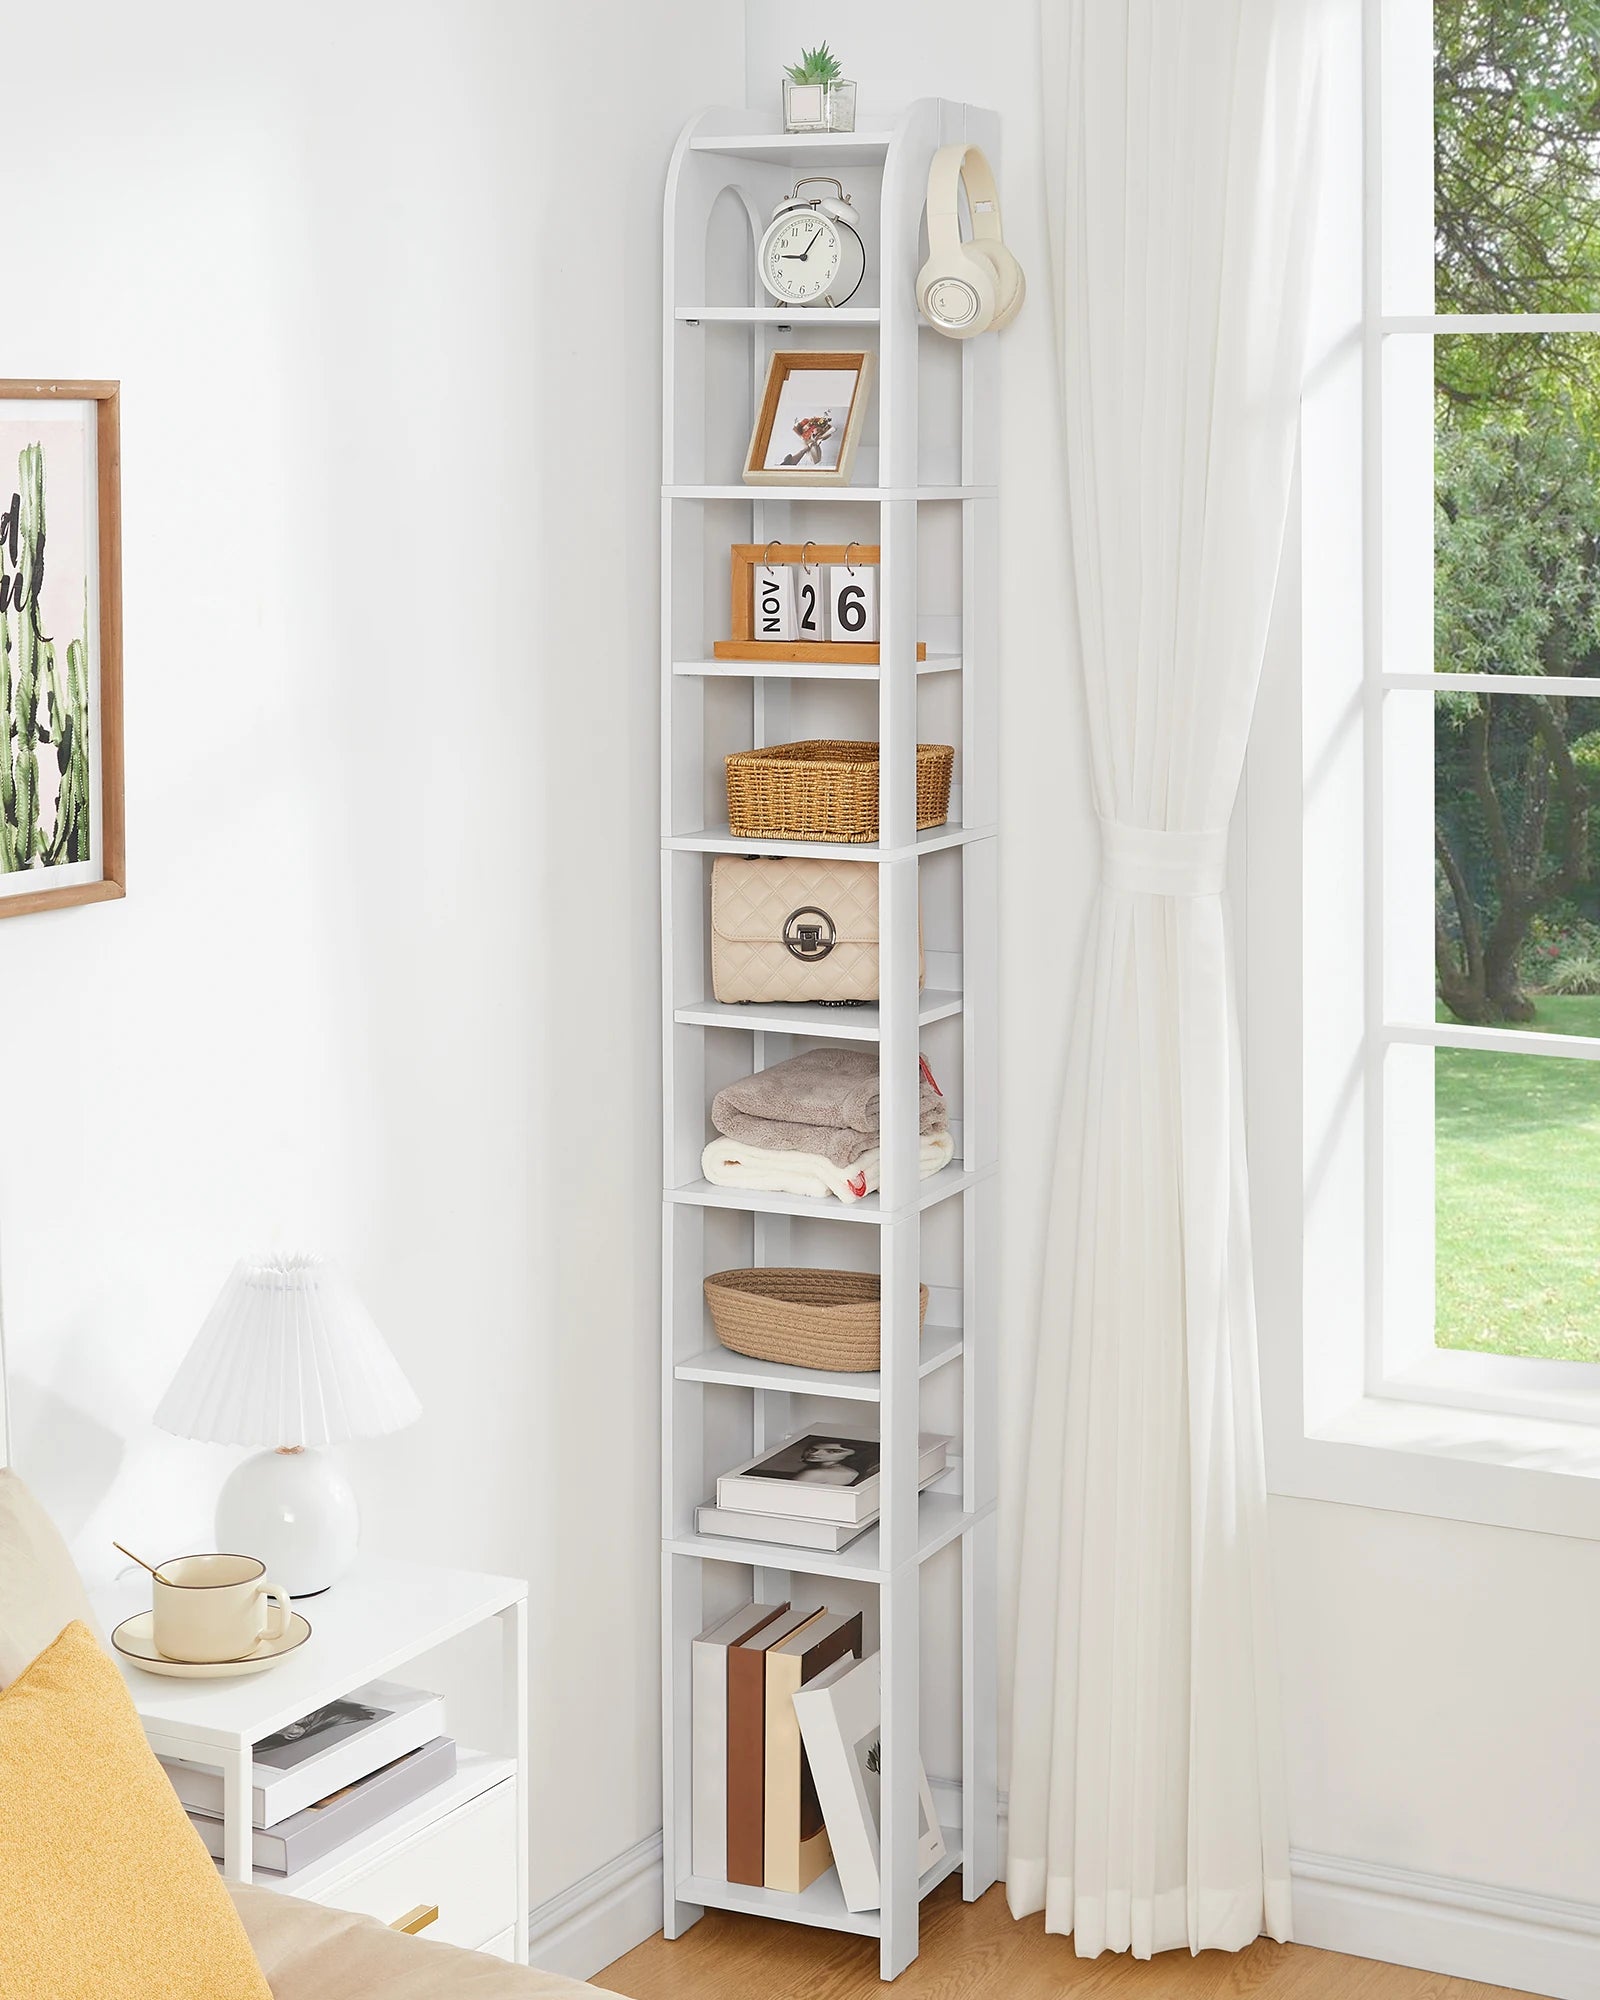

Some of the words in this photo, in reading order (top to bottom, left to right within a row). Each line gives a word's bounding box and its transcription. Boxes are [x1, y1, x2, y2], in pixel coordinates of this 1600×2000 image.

[791, 227, 799, 237] 11
[804, 223, 814, 232] 12
[780, 239, 789, 248] 10
[828, 239, 835, 248] 2
[774, 253, 780, 262] 9
[831, 255, 837, 264] 3
[777, 269, 783, 278] 8
[825, 270, 831, 278] 4
[786, 281, 792, 289] 7
[799, 285, 806, 294] 6
[814, 281, 820, 290] 5
[762, 580, 781, 632] NOV
[801, 584, 816, 631] 2
[837, 585, 867, 632] 6
